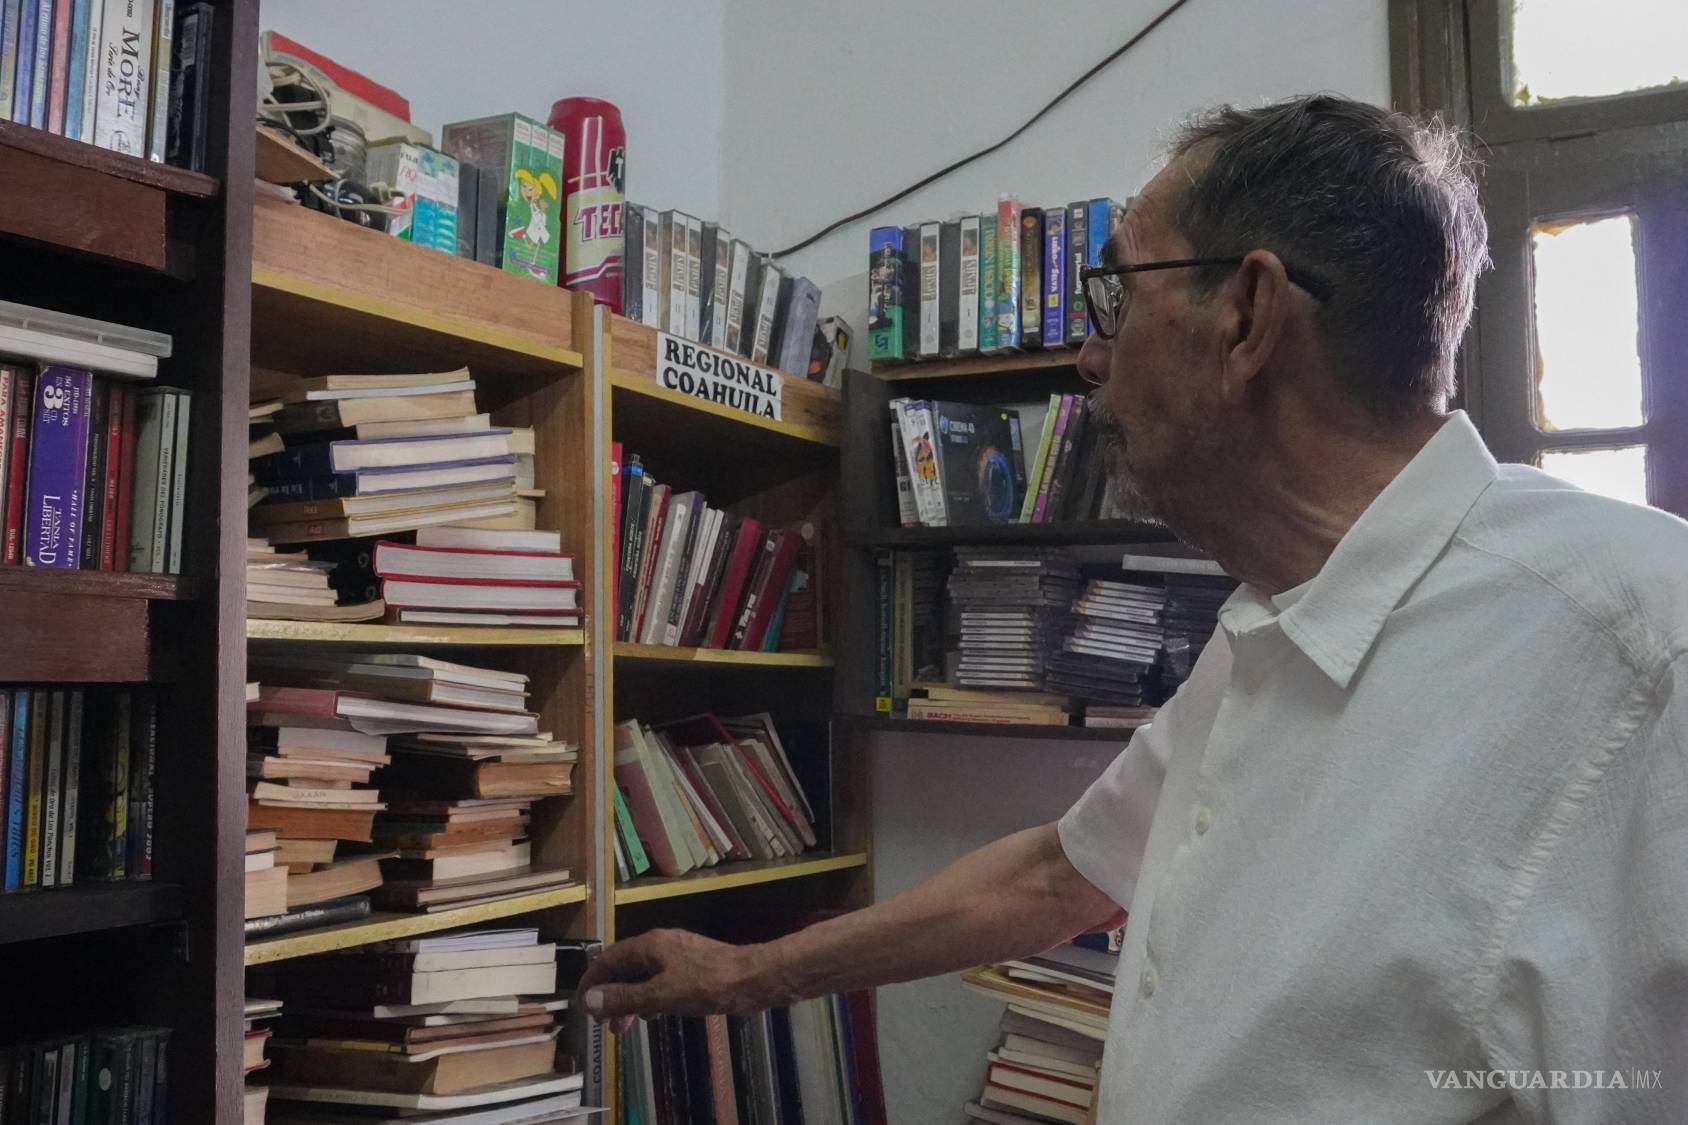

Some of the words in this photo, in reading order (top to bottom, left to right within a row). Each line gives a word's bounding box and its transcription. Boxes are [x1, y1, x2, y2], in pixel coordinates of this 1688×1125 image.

[573, 202, 624, 241] TEC
[664, 337, 777, 397] REGIONAL
[43, 385, 64, 410] 3
[663, 366, 776, 419] COAHUILA
[70, 493, 78, 518] HALL
[38, 494, 61, 565] LIBERTAD
[52, 507, 62, 550] TANIA
[69, 521, 76, 535] OF
[67, 536, 75, 562] FAME
